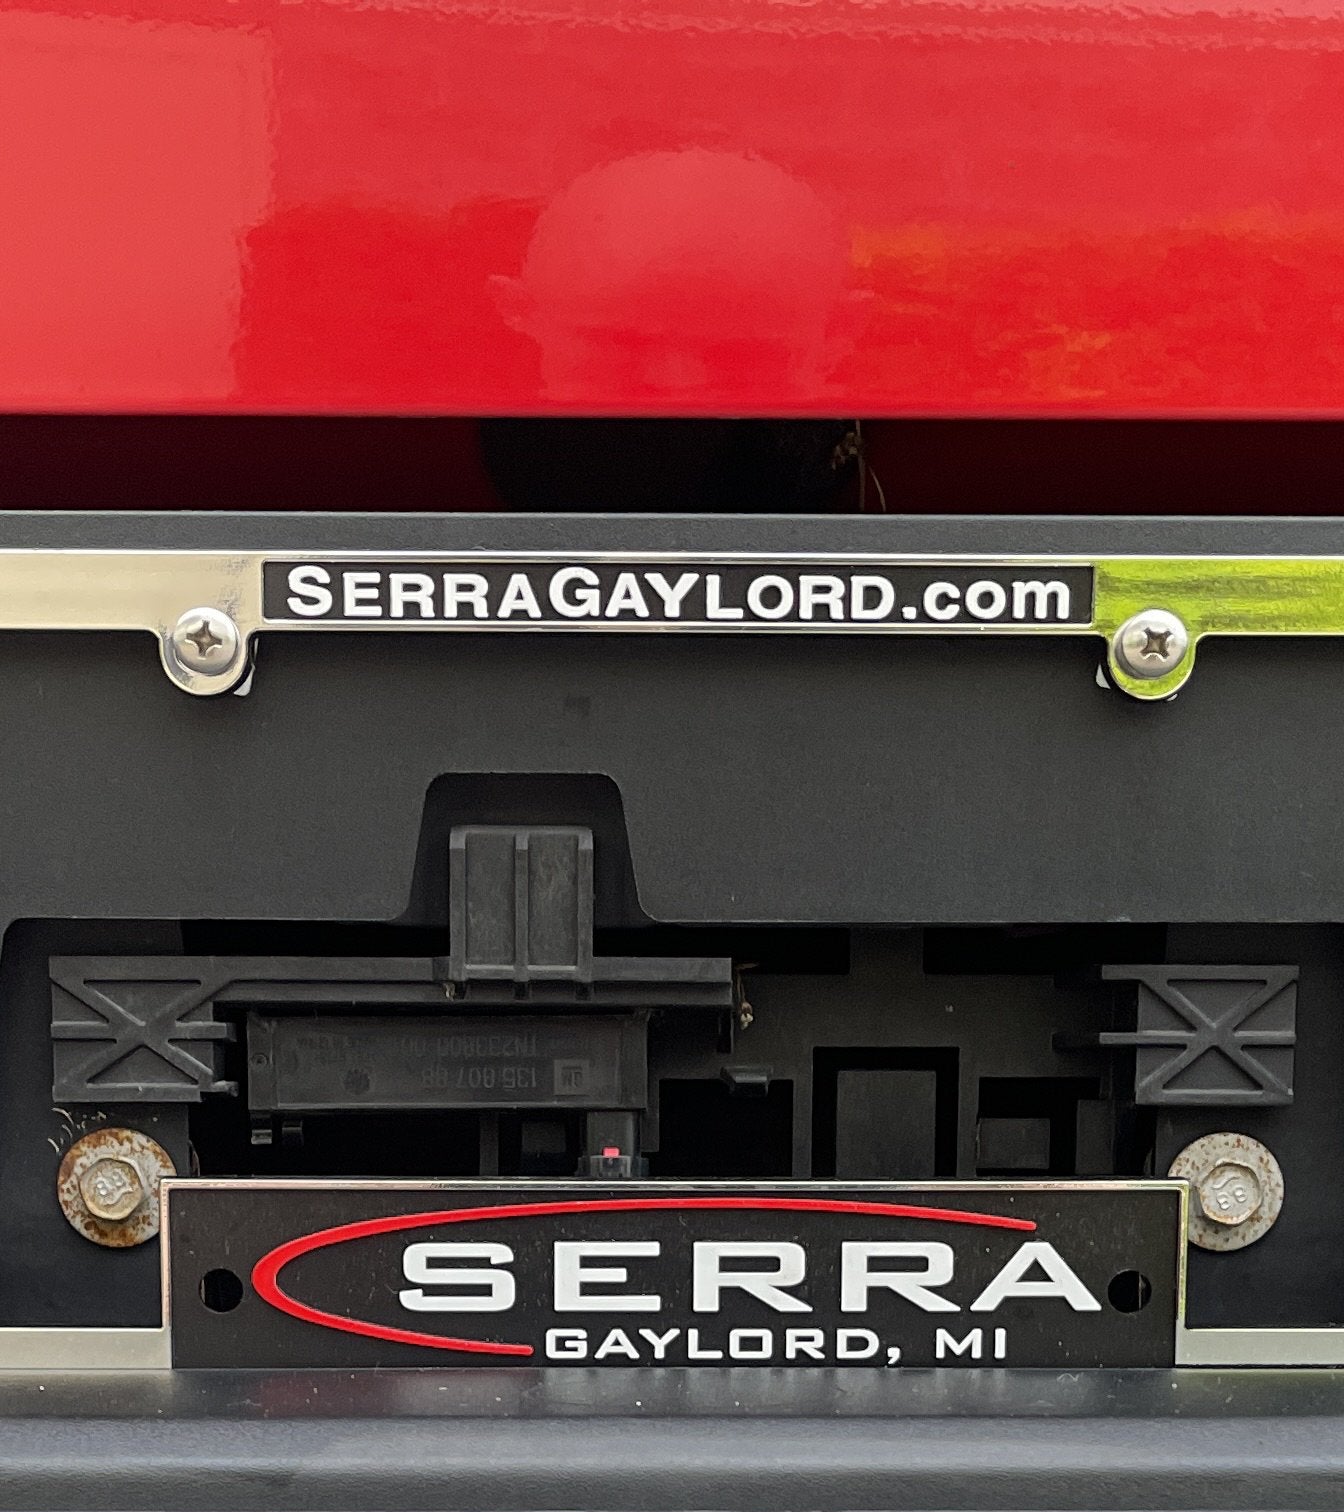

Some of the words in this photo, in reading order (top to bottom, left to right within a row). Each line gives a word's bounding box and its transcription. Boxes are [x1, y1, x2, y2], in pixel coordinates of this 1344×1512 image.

[286, 565, 1070, 620] SERRAGAYLORD.com
[399, 1241, 1102, 1312] SERRA
[545, 1328, 901, 1365] GAYLORD,
[935, 1327, 1007, 1359] MI
